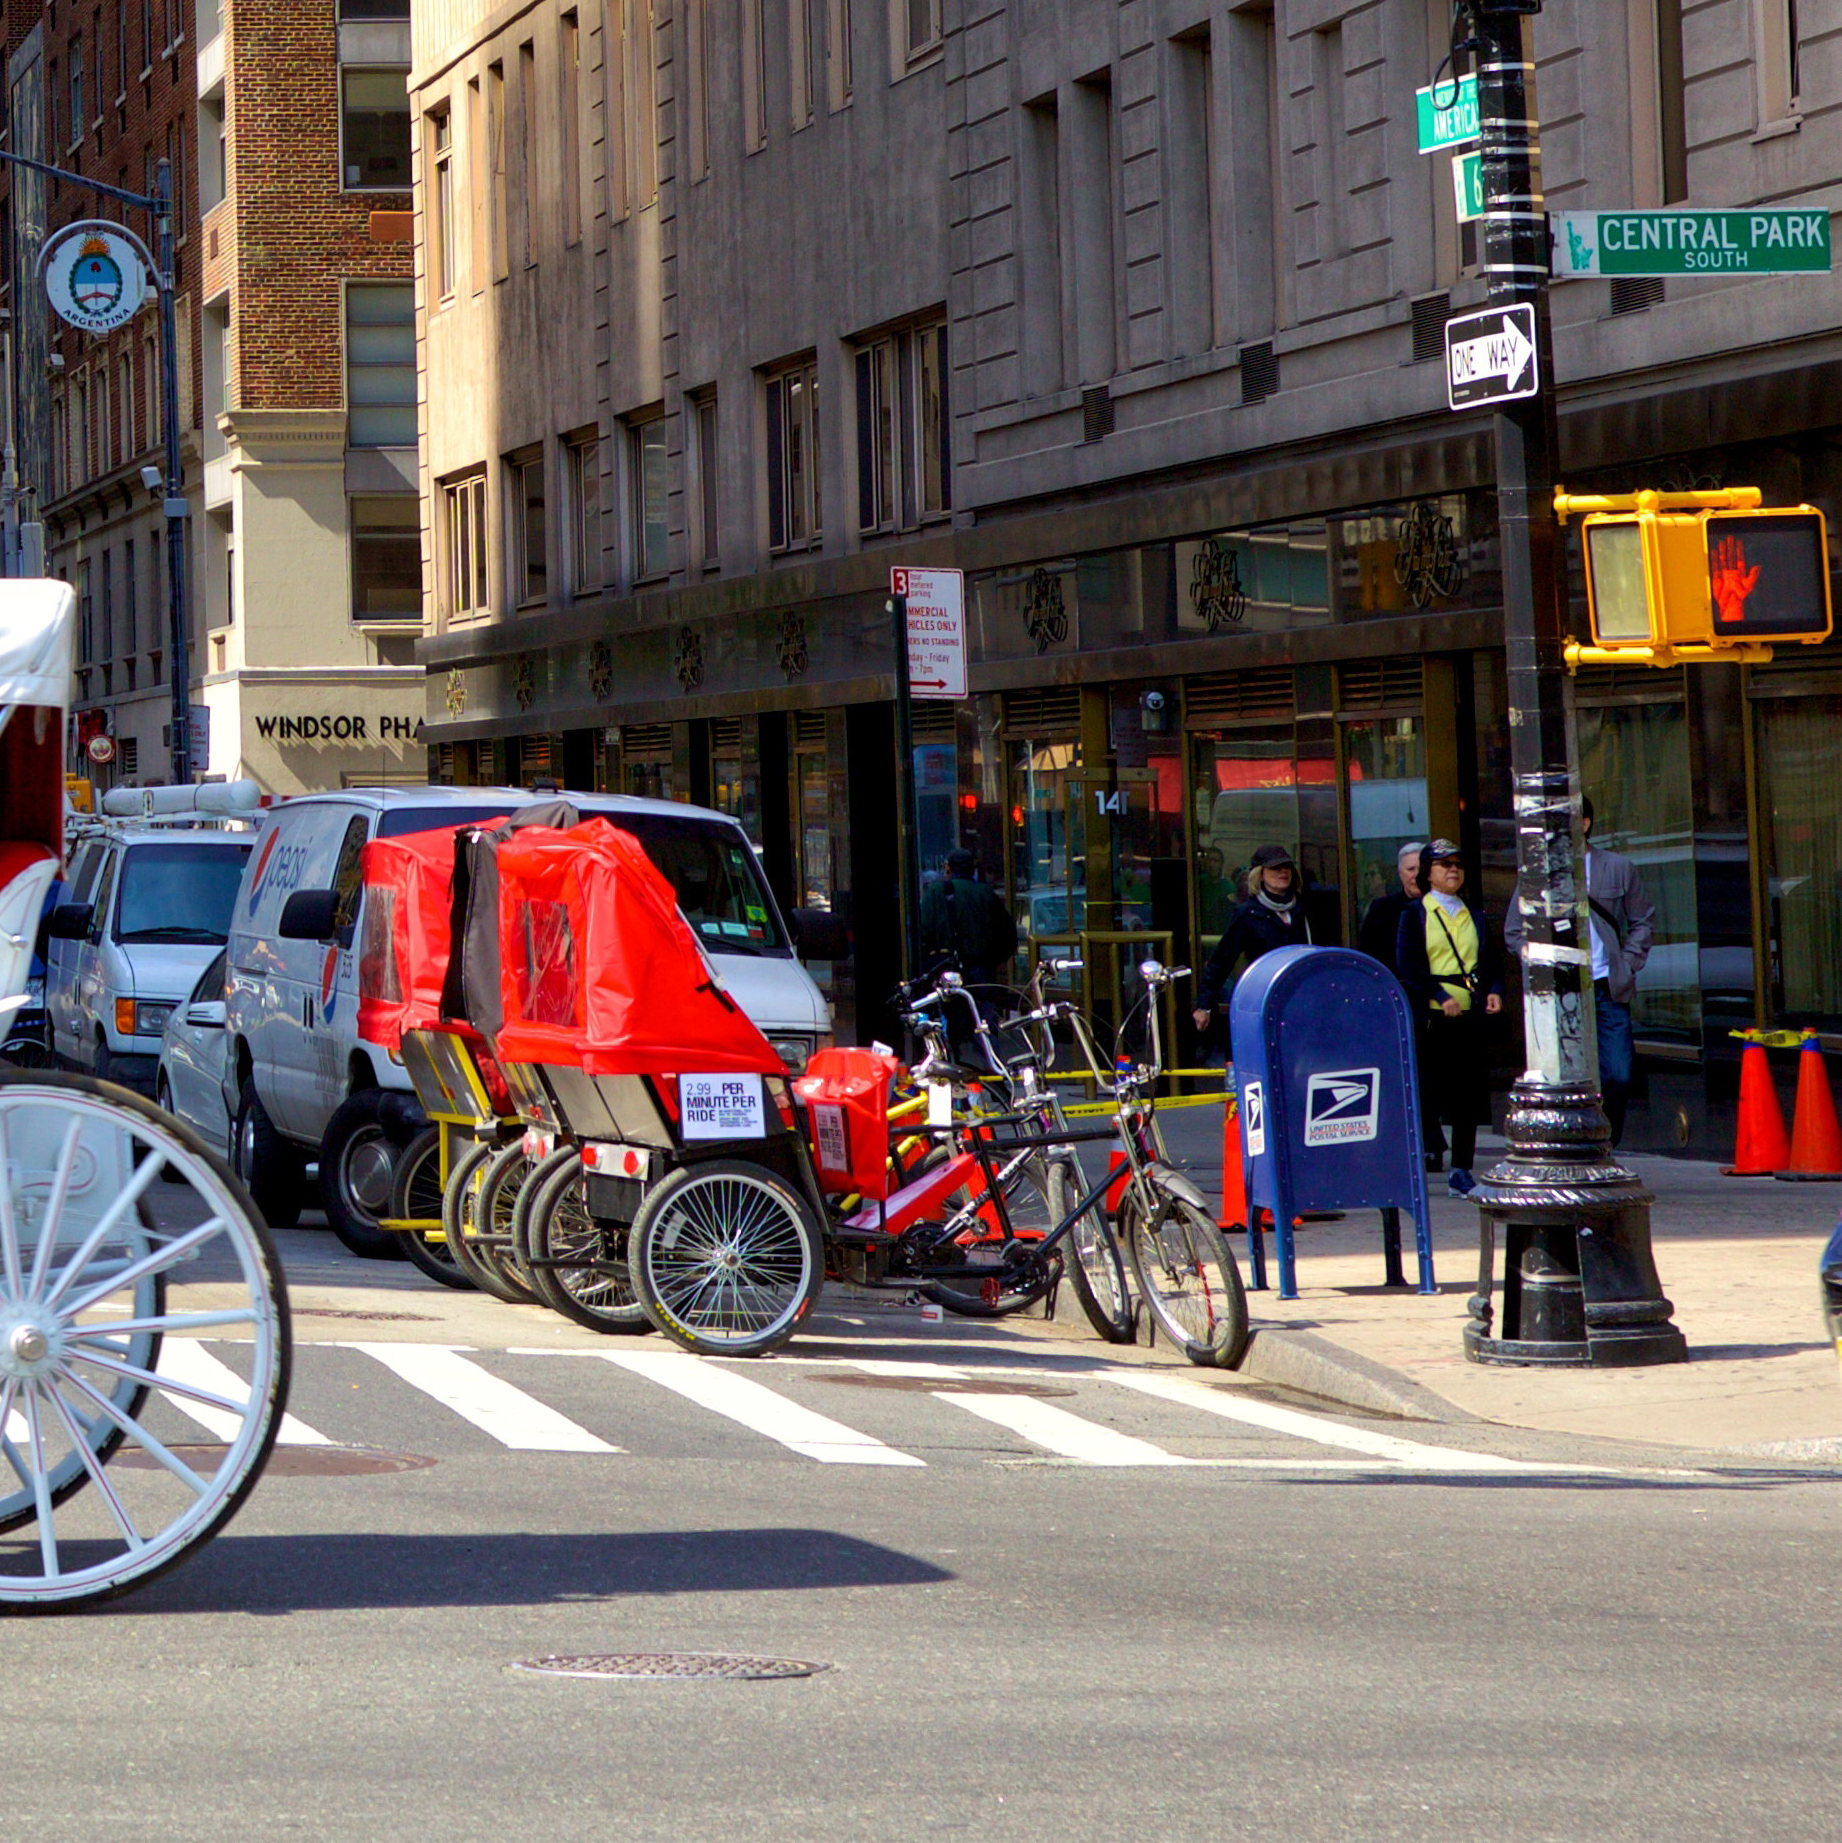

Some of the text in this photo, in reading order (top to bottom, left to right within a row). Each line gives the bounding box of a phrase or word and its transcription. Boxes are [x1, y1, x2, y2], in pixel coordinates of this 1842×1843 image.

[1434, 102, 1480, 142] AMERICA
[1474, 163, 1483, 208] 6
[1603, 216, 1825, 251] CENTRAL PARK
[1684, 251, 1748, 268] SOUTH
[63, 308, 130, 327] ARGENTINA
[1455, 335, 1518, 379] ONE WAY
[896, 571, 907, 594] 3
[907, 607, 949, 618] MMERCIAL
[908, 621, 957, 632] HICLES ONLY
[922, 638, 929, 646] NO
[931, 638, 960, 647] STANDING
[908, 653, 950, 664] nday Friday
[255, 716, 425, 739] WINDSOR PHA
[264, 836, 313, 901] pepsi
[686, 1083, 745, 1096] 2.99 PER
[686, 1096, 757, 1109] MINUTE PER
[687, 1109, 717, 1122] RIDE
[1309, 1120, 1368, 1134] UNITED STATES
[1309, 1127, 1371, 1141] POSTAL SERVICE
